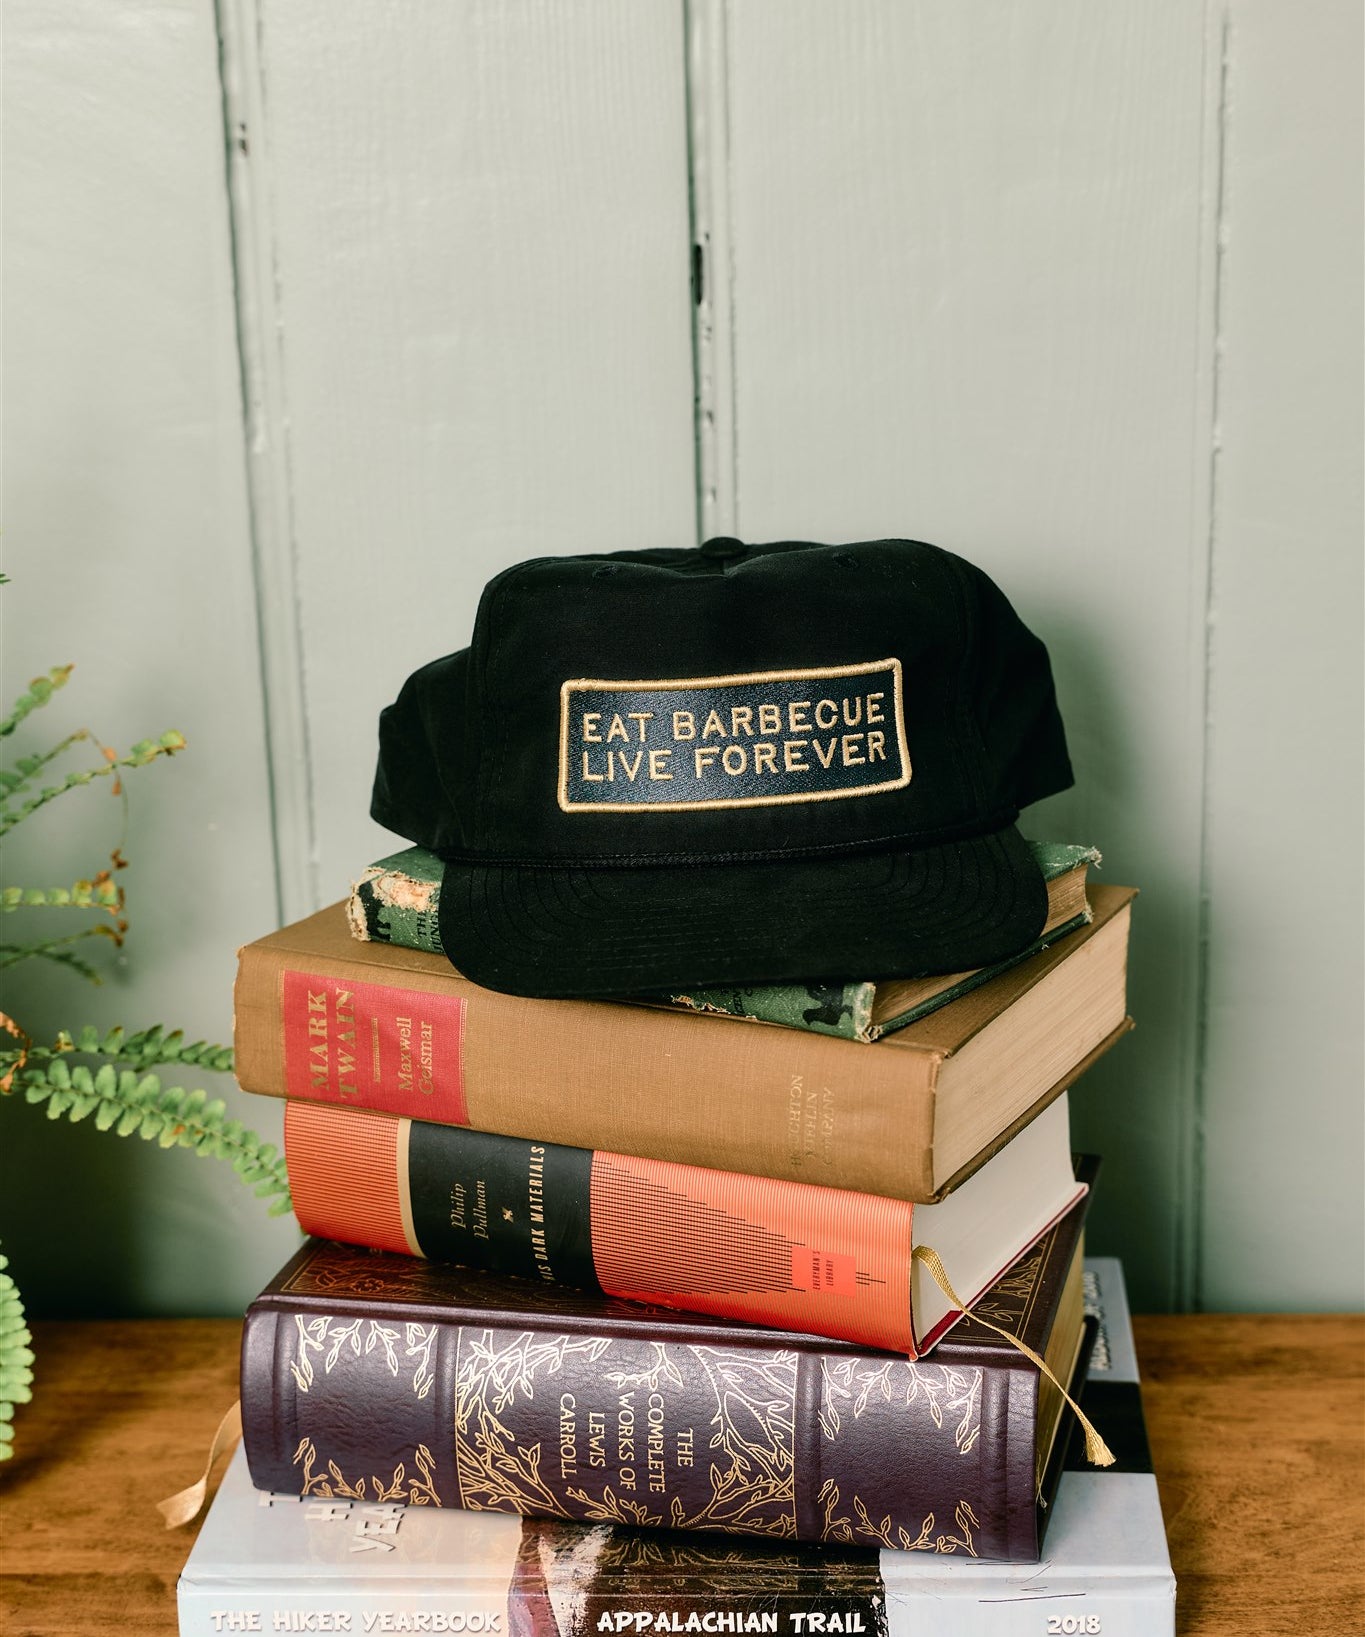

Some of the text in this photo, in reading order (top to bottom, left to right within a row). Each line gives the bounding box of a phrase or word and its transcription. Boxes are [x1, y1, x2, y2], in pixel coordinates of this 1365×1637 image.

[582, 692, 885, 743] EAT BARBECUE
[582, 730, 887, 782] LIVE FOREVER
[308, 990, 330, 1092] MARK
[335, 987, 358, 1099] TWAIN
[396, 1017, 414, 1092] Maxwell
[418, 1020, 434, 1095] Geismar
[450, 1183, 467, 1230] Philip
[473, 1179, 489, 1241] Pullman
[529, 1145, 546, 1223] MATERIALS
[530, 1228, 549, 1261] DARK
[560, 1393, 578, 1479] CARROLL
[589, 1412, 606, 1467] LEWIS
[618, 1391, 637, 1491] WORKS OF
[647, 1393, 666, 1493] COMPLETE
[677, 1427, 694, 1467] THE
[210, 1610, 502, 1633] THE HIKER YEARBOOK
[597, 1611, 866, 1634] APPALACHIAN TRAIL
[1046, 1614, 1101, 1635] 2018
